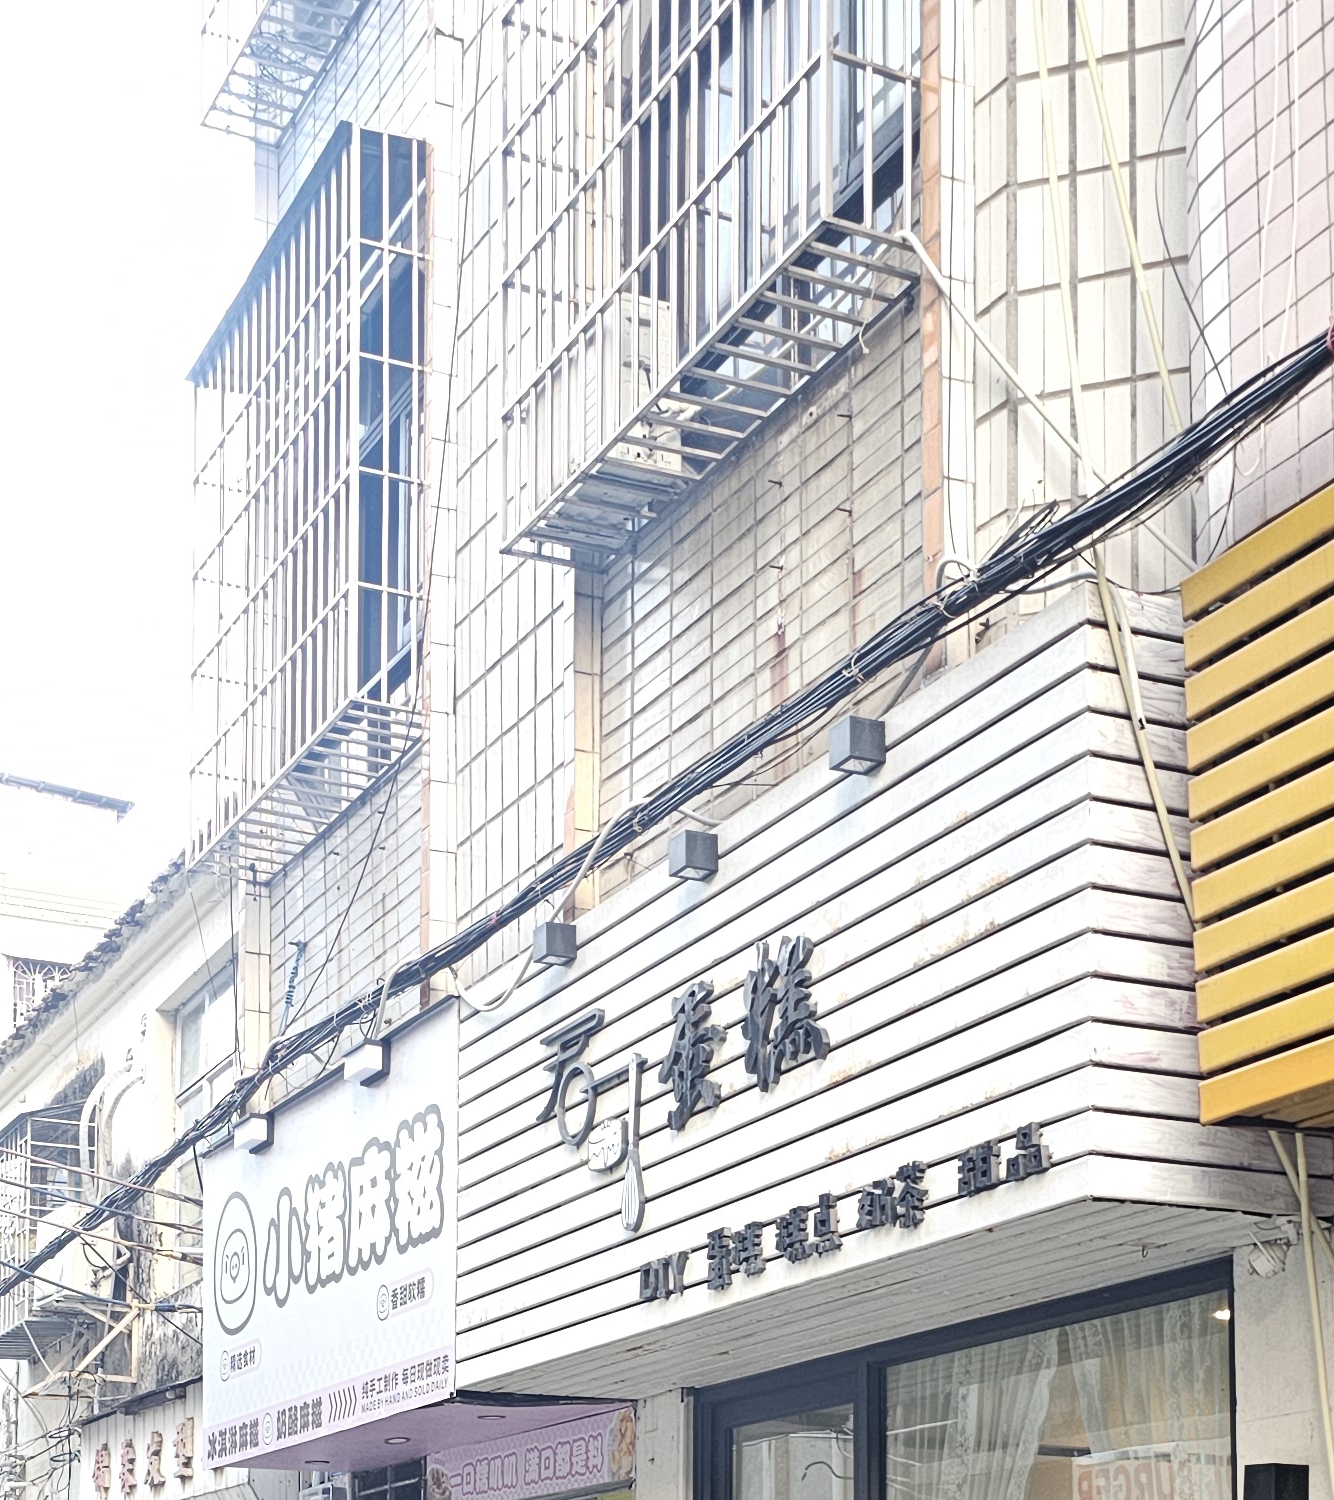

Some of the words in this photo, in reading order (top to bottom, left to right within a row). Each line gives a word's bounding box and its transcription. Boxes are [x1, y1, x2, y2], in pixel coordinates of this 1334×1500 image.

[262, 1103, 445, 1308] 小猪麻糍
[361, 1371, 400, 1400] 纯手工制作
[401, 1353, 450, 1387] 每日现做现卖
[361, 1399, 377, 1413] MADE
[384, 1392, 401, 1407] HAND
[401, 1389, 413, 1403] AND
[431, 1377, 449, 1395] DAILY
[207, 1417, 259, 1461] 冰淇淋麻糍
